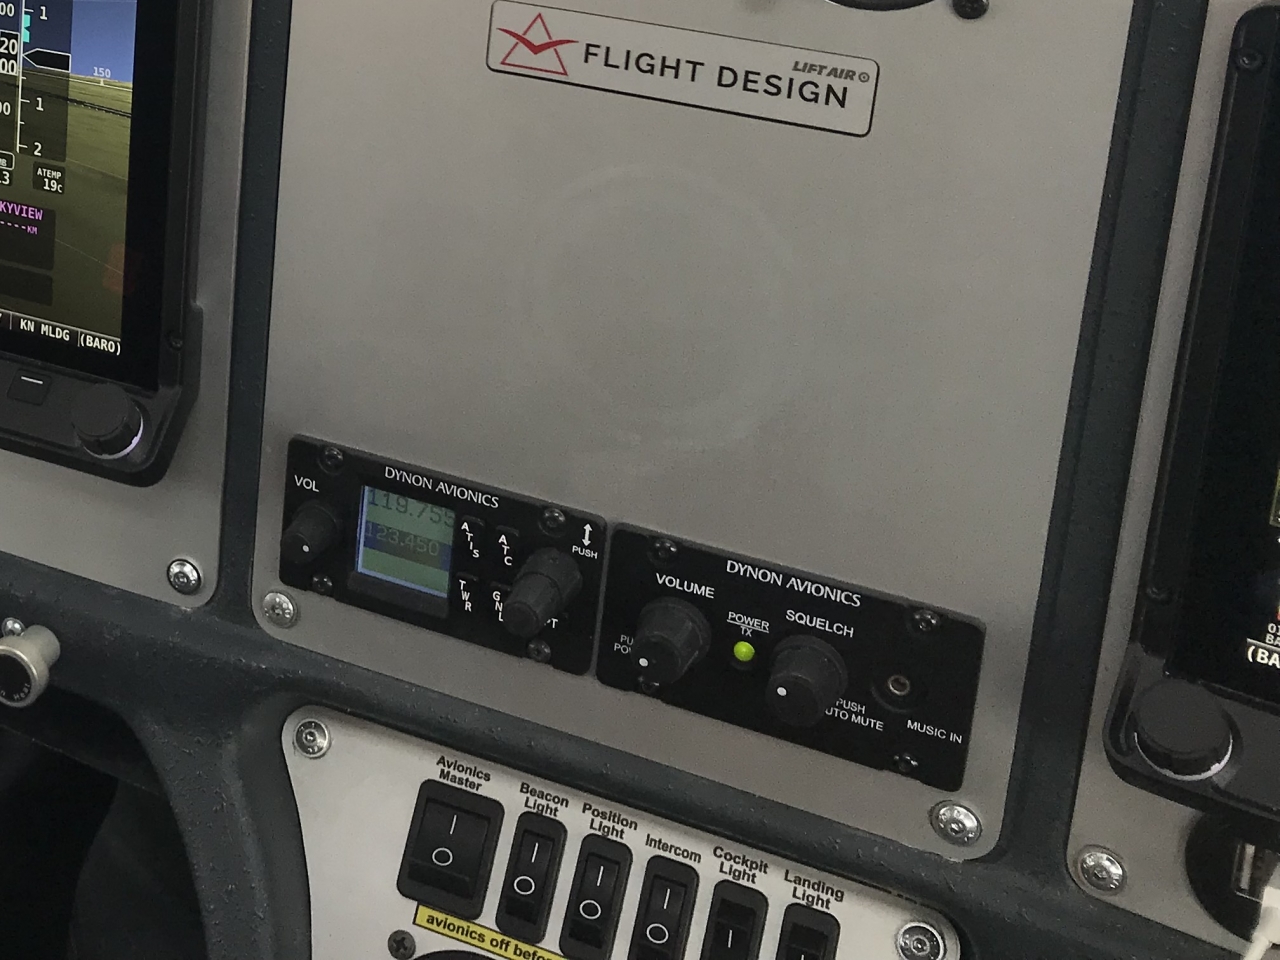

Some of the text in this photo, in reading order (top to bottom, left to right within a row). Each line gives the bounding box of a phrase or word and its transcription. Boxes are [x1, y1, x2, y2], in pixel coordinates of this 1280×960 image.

[583, 42, 848, 109] FLIGHT DESIGN
[37, 168, 62, 179] ATEMP
[20, 318, 35, 333] KN
[40, 324, 70, 342] MLDG
[80, 333, 121, 356] (BARO)
[294, 474, 319, 493] VOL
[384, 466, 499, 510] DYNON AVIONICS
[368, 488, 455, 528] 119.755
[365, 522, 440, 556] 123.450
[461, 521, 480, 558] ATIS
[498, 534, 513, 566] ATC
[572, 544, 598, 560] PUSH
[459, 579, 472, 612] TWR
[726, 559, 862, 607] DYNON AVIONICS
[655, 572, 855, 639] VOLUME SQUELCH
[727, 611, 770, 632] POWER
[740, 626, 754, 638] TX
[825, 706, 884, 731] UTO MUTE
[835, 697, 866, 714] PUSH
[907, 719, 963, 744] MUSIC IN
[436, 754, 491, 783] Avionics
[438, 768, 483, 792] Master
[519, 782, 570, 808] Beacon
[524, 796, 560, 818] Light
[582, 802, 639, 831] Position
[589, 818, 625, 840] Light
[645, 832, 702, 864] Intercom
[713, 845, 769, 875] Cockpit
[719, 860, 757, 884] Light
[784, 869, 845, 902] Landing
[792, 888, 832, 911] Light
[426, 913, 511, 952] avionics off
